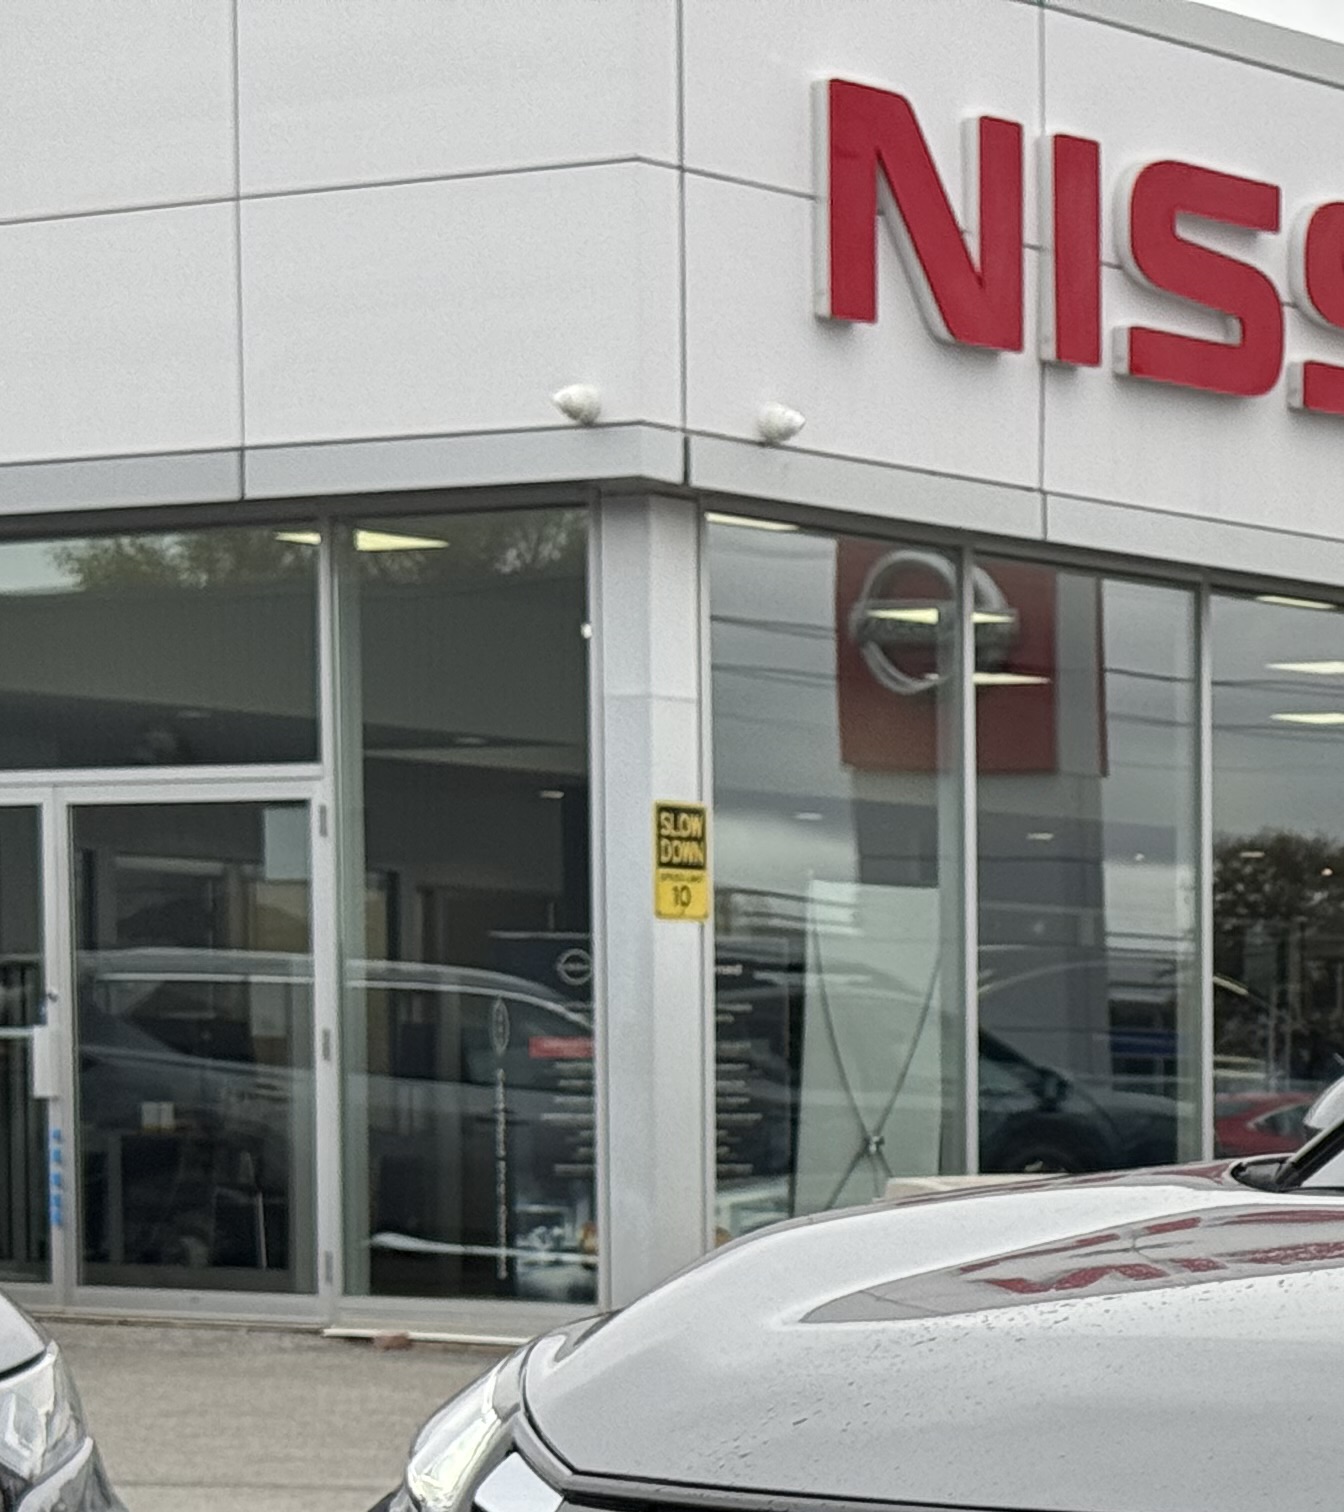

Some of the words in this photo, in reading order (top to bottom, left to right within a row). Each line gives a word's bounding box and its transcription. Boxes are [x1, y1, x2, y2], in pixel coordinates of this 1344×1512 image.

[659, 811, 703, 838] SLOW
[659, 838, 704, 866] DOWN
[672, 884, 693, 908] 10
